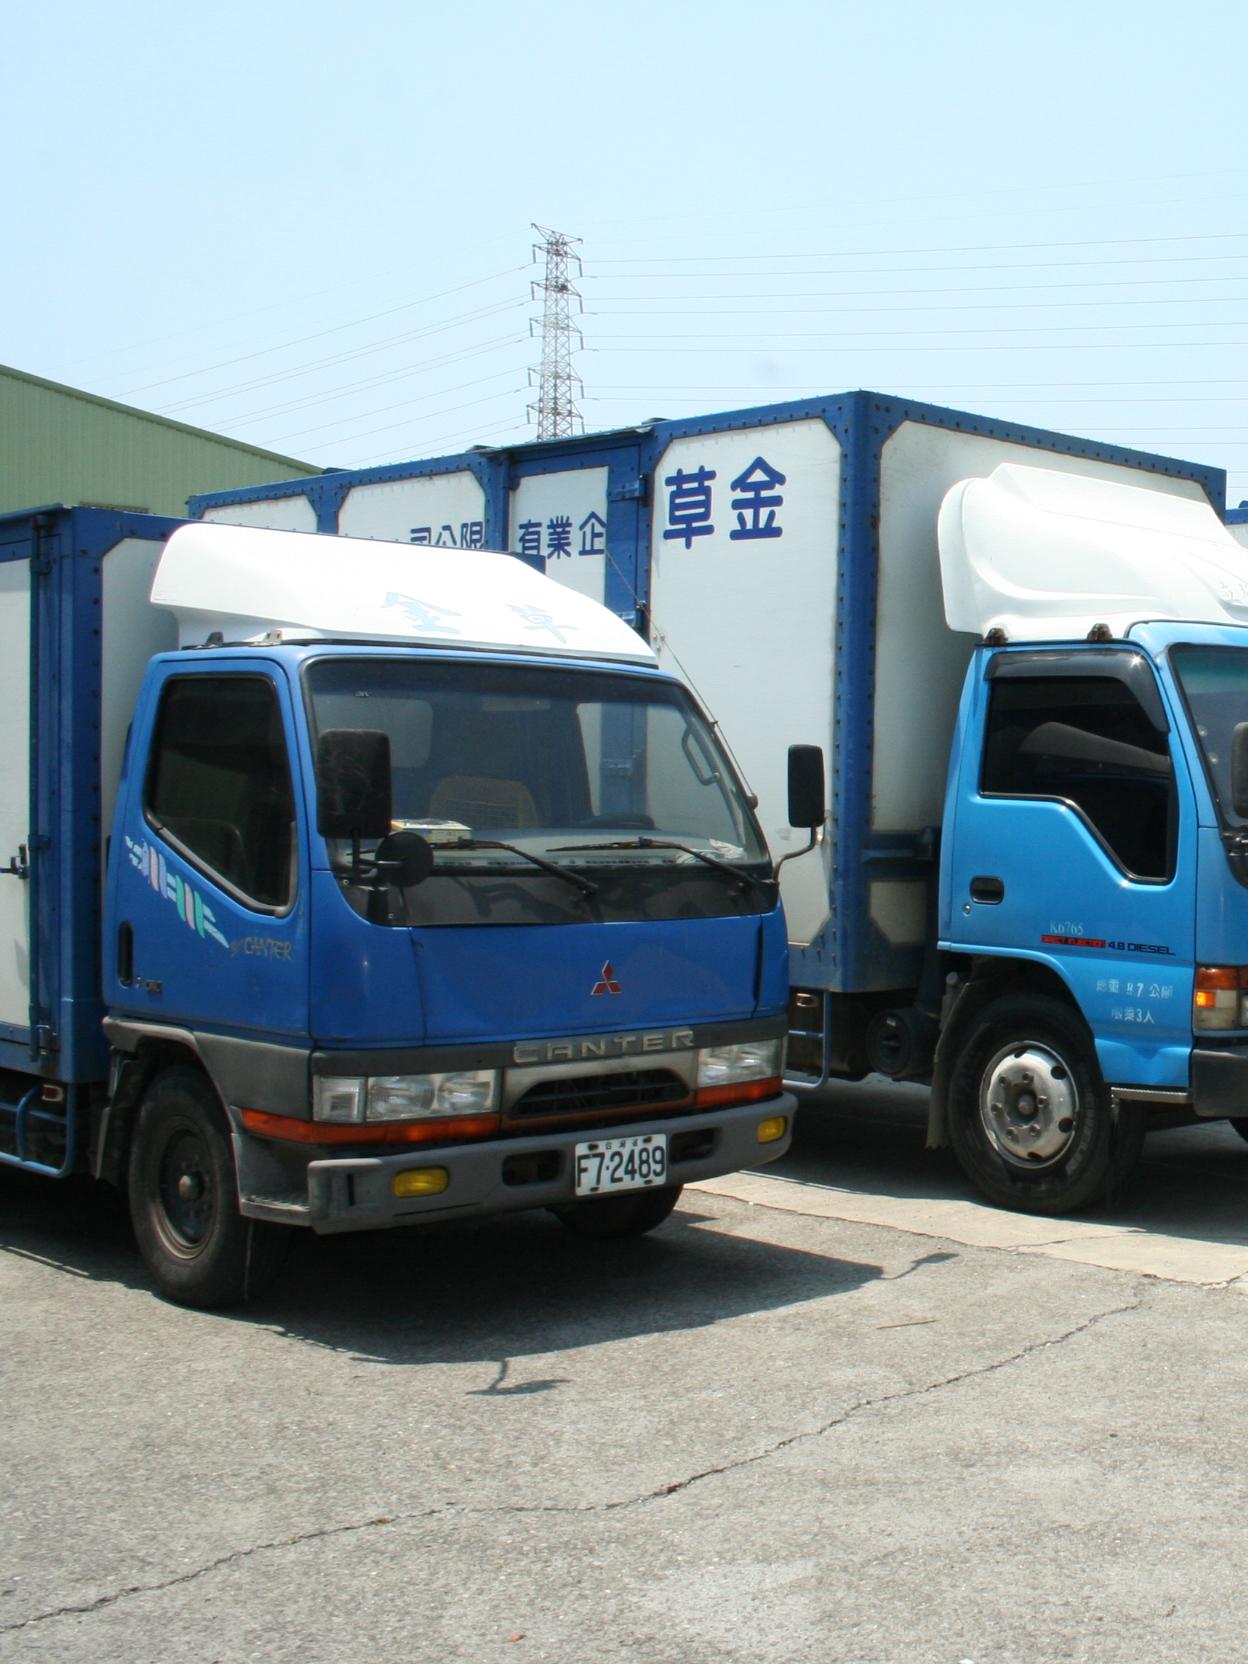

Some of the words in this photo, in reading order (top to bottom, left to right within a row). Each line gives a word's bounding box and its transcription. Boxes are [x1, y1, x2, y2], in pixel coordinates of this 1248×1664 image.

[1108, 941, 1125, 951] 4.8
[1127, 942, 1176, 956] DIESEL
[513, 1030, 695, 1063] CANTER
